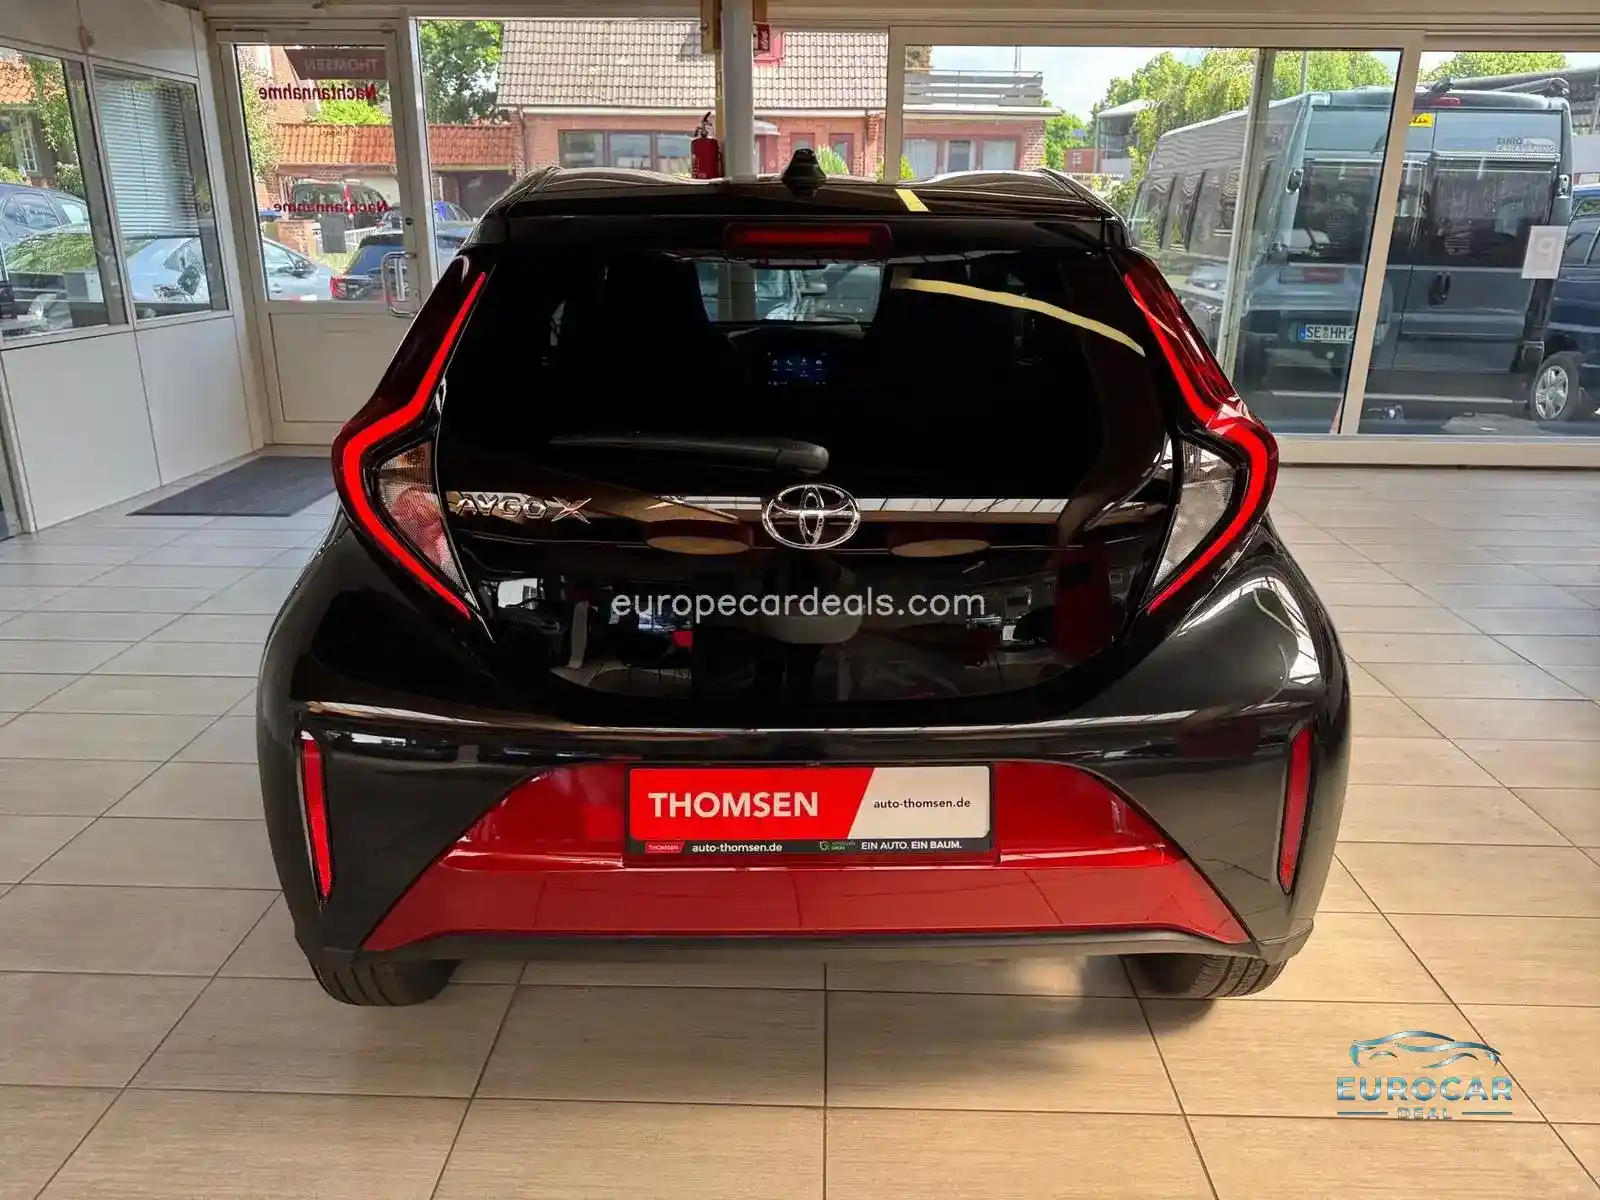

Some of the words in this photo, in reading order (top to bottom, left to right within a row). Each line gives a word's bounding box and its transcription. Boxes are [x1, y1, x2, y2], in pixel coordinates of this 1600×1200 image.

[1306, 326, 1322, 339] SE
[1330, 327, 1347, 339] HH
[455, 494, 547, 519] AYGO
[648, 791, 819, 819] THOMSEN
[873, 797, 971, 809] auto-thomsen.de
[691, 842, 783, 853] auto-thomsen.de
[861, 841, 878, 850] EIN
[879, 841, 910, 850] AUTO.
[911, 841, 928, 850] EIN
[929, 840, 962, 850] BAUM.
